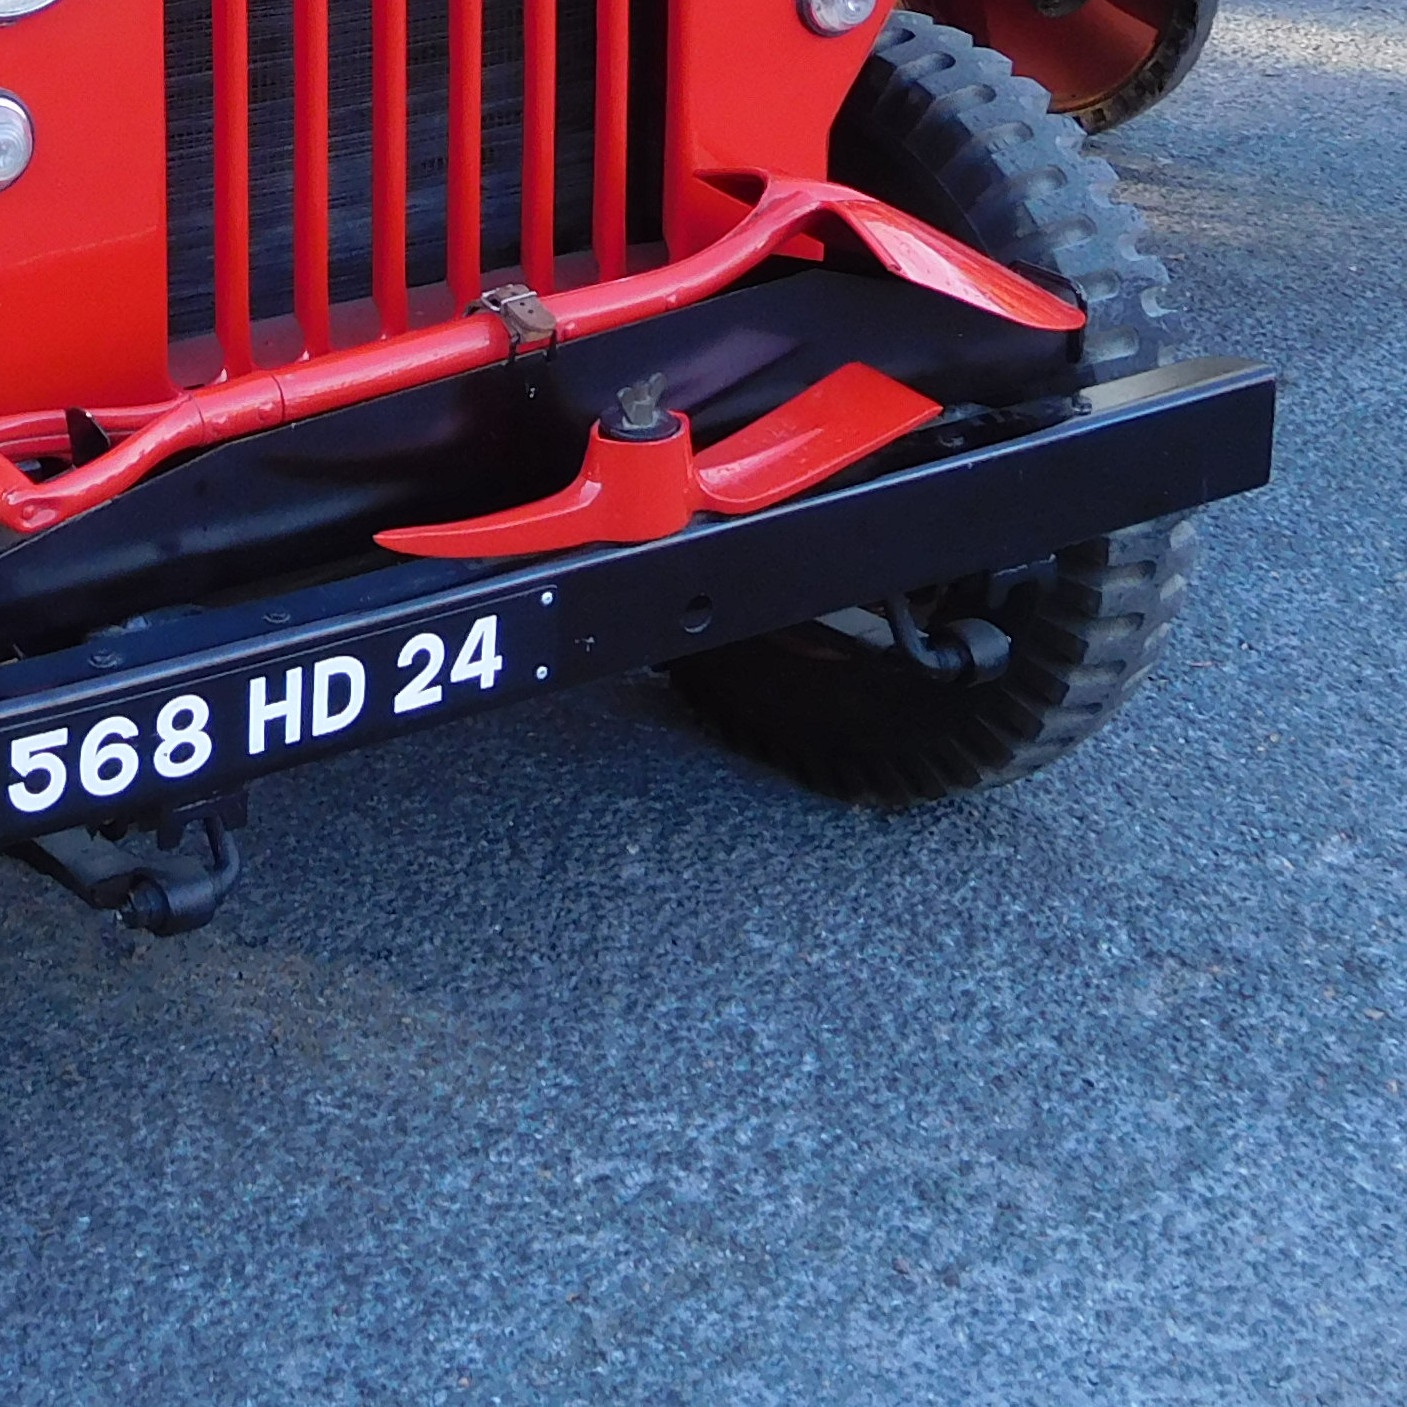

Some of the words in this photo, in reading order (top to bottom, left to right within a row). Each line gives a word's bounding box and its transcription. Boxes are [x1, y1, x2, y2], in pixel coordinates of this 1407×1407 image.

[7, 694, 212, 813] 568
[247, 655, 367, 756] HD
[393, 614, 503, 715] 24
